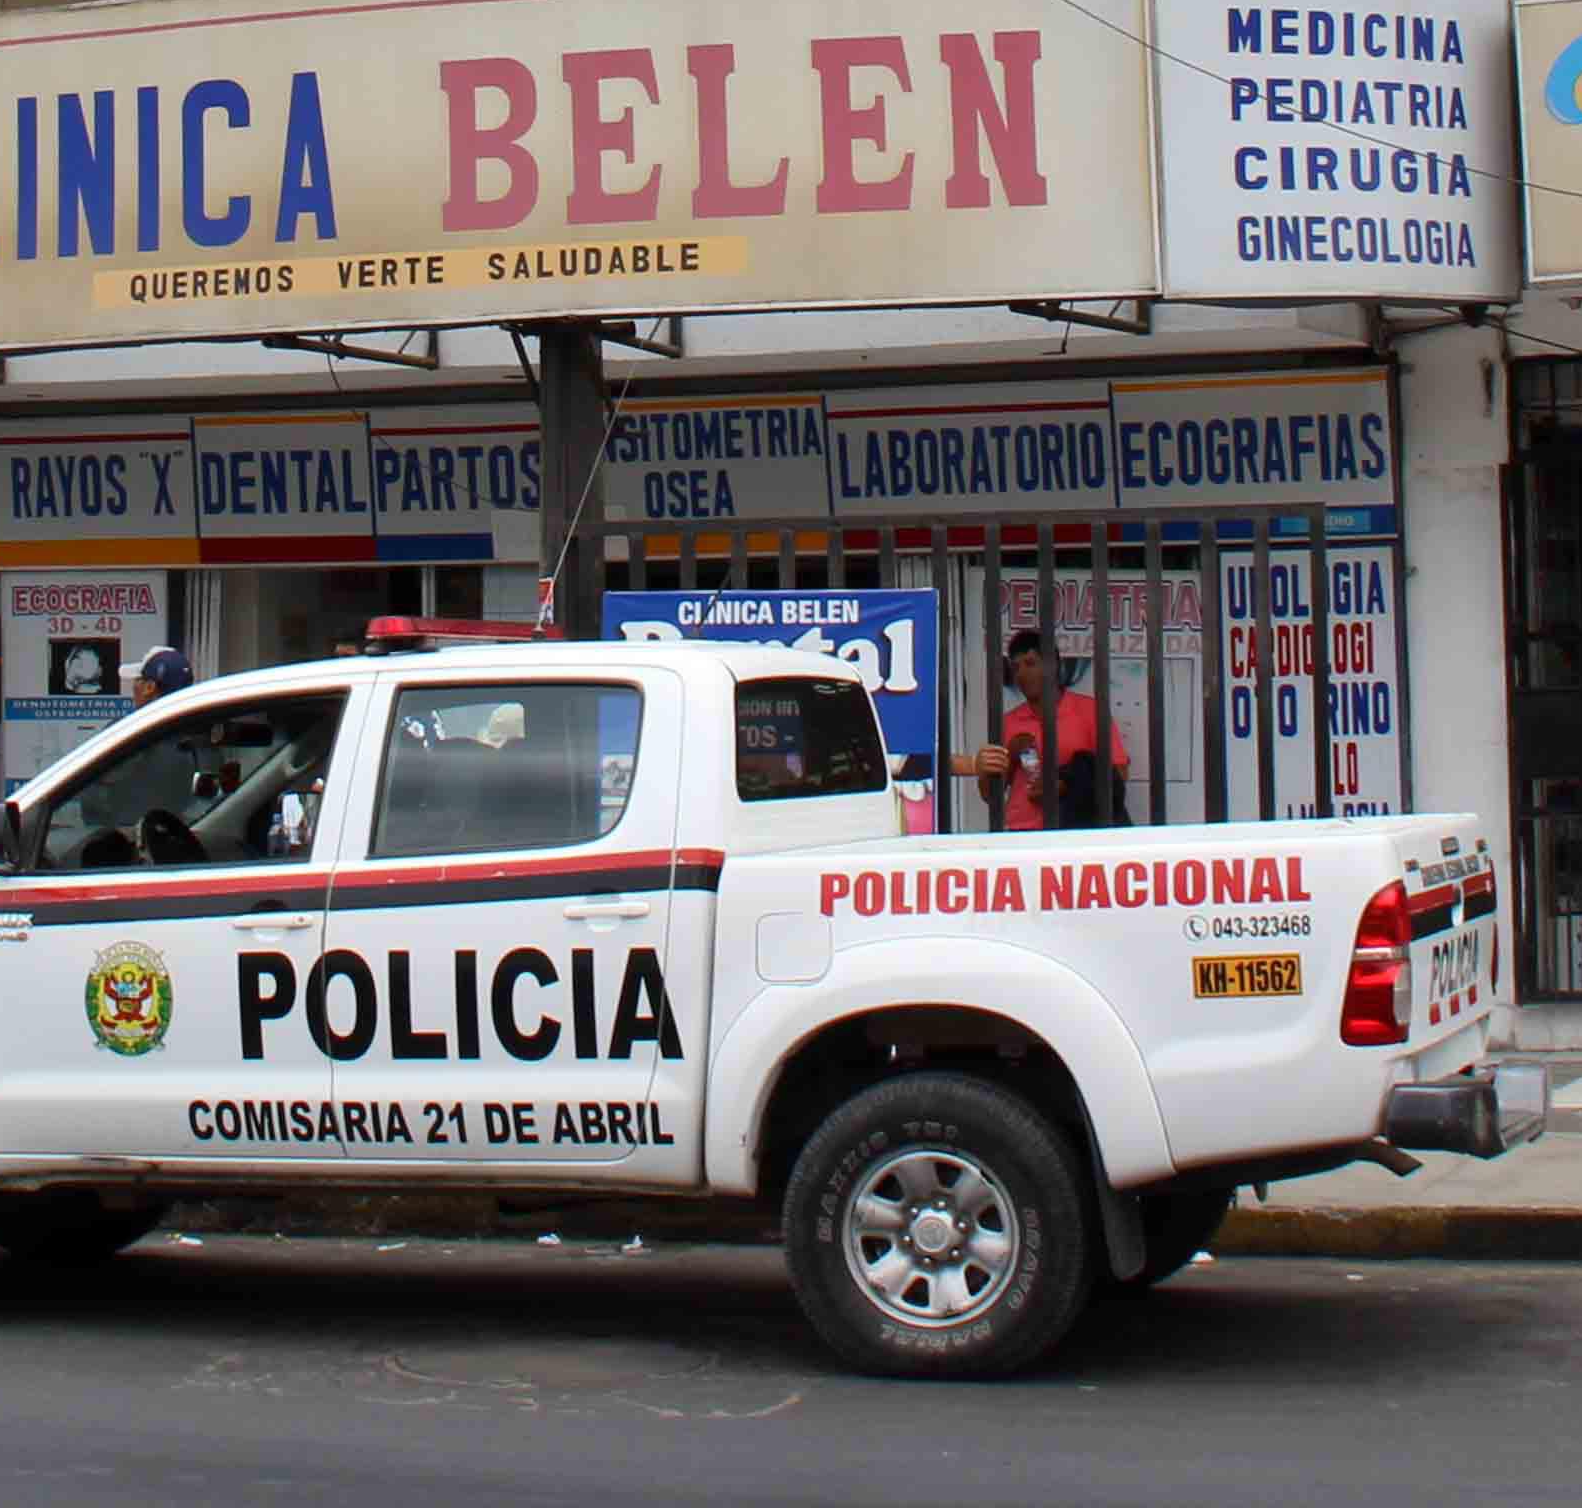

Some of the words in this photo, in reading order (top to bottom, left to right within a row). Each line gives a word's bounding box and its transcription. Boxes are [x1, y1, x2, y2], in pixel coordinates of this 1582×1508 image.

[1226, 8, 1465, 64] MEDICINA
[439, 29, 1048, 232] BELEN
[1230, 77, 1468, 130] PEDIATRIA
[1233, 146, 1472, 197] CIRUGIA
[1237, 215, 1476, 268] GINECOLOGIA
[129, 264, 295, 303] QUEREMOS
[337, 254, 444, 290] VERTE
[487, 243, 700, 282] SALUDABLE
[373, 441, 540, 512] PARTOS
[837, 423, 1106, 498] LABORATORIO
[1119, 412, 1386, 489] ECOGRAFIAS
[11, 454, 128, 519] RAYOS
[200, 448, 369, 515] DENTAL
[644, 469, 735, 519] OSEA
[12, 584, 156, 615] ECOGRAFIA
[48, 617, 74, 634] 3D
[95, 617, 122, 633] 4D
[781, 600, 860, 625] BELEN
[819, 867, 1027, 917] POLICIA
[1040, 856, 1312, 912] NACIONAL
[1212, 915, 1312, 938] 043-323468
[1198, 959, 1297, 994] KH-11562
[237, 946, 685, 1062] POLICIA
[188, 1099, 413, 1144] COMISARIA
[423, 1101, 466, 1143] 21
[485, 1102, 540, 1144] DE
[553, 1101, 675, 1146] ABRIL
